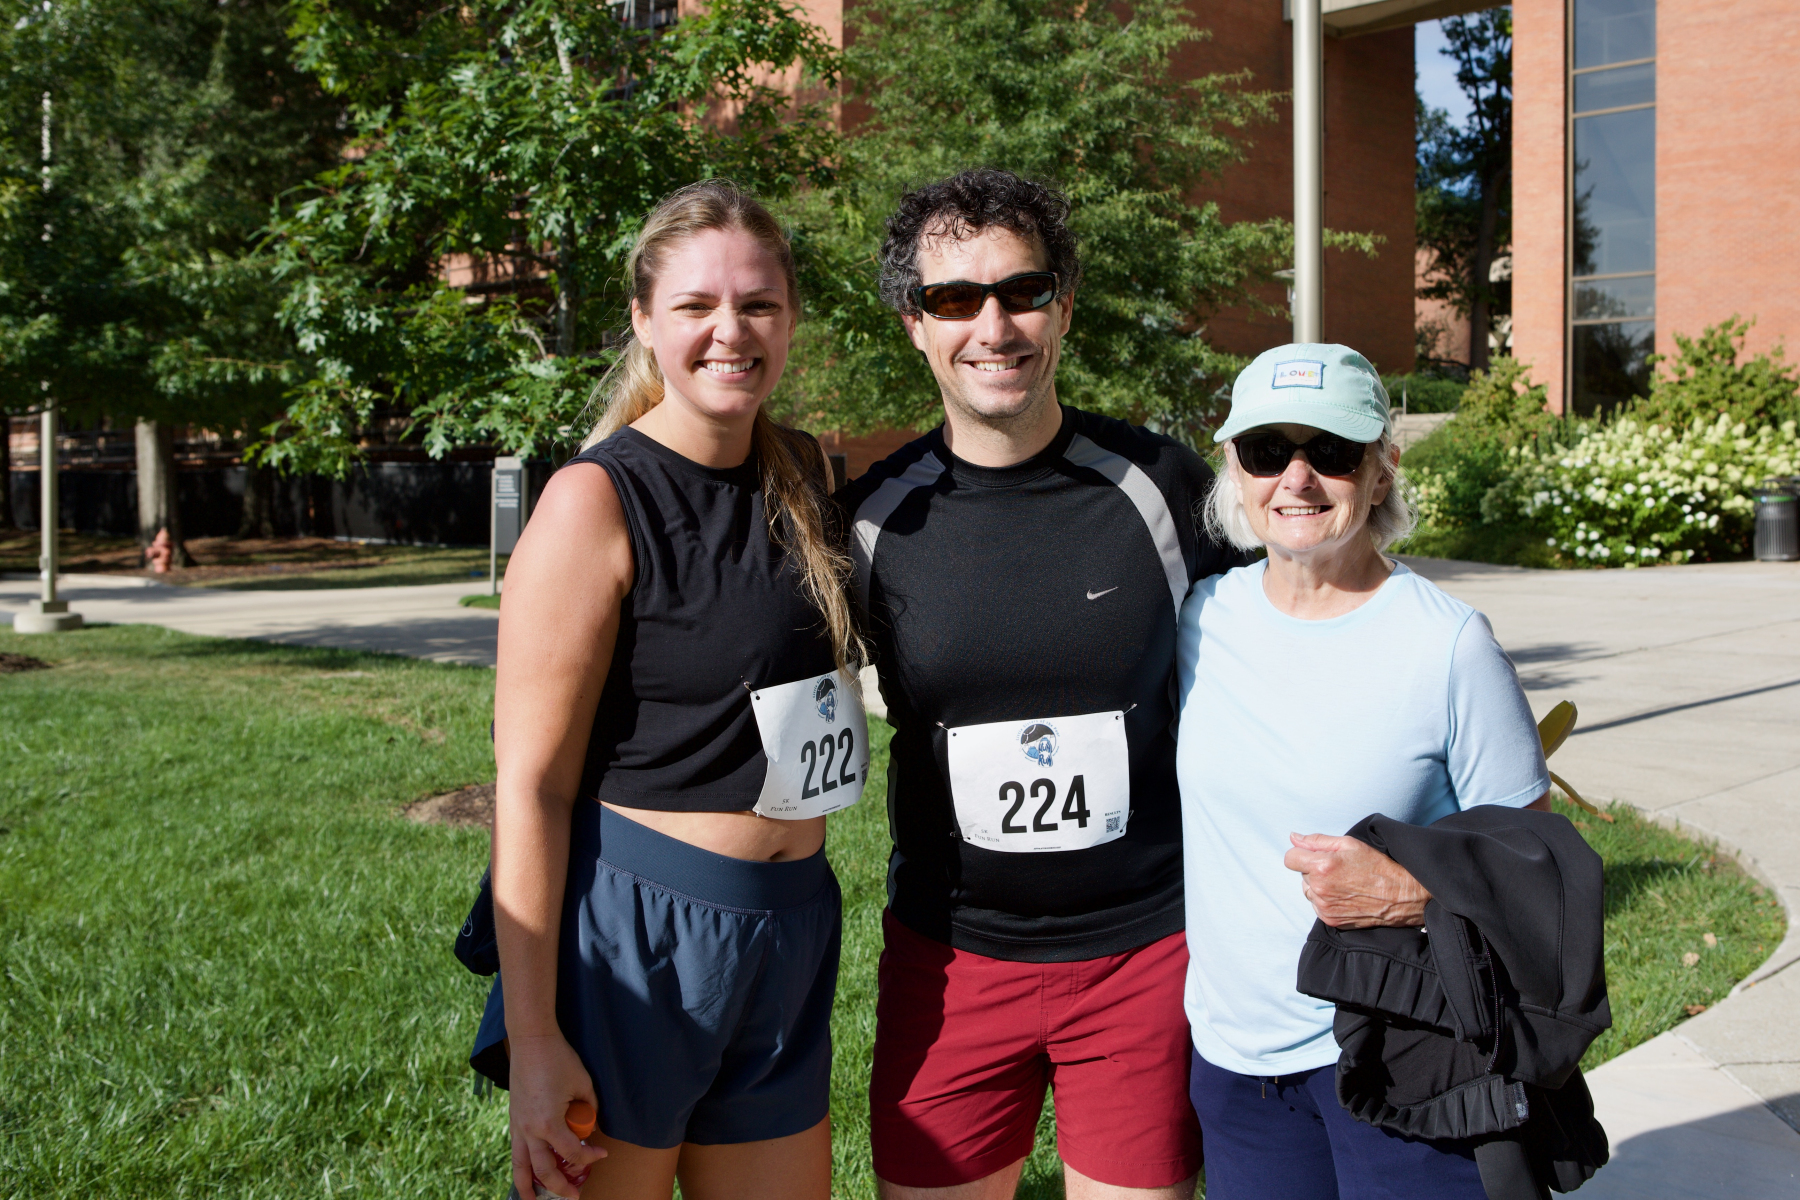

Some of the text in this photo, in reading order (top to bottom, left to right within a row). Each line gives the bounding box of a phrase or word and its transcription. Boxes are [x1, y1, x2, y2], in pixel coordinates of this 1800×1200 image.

[1280, 370, 1316, 378] LOVE
[801, 727, 856, 800] 222
[999, 774, 1091, 834] 224
